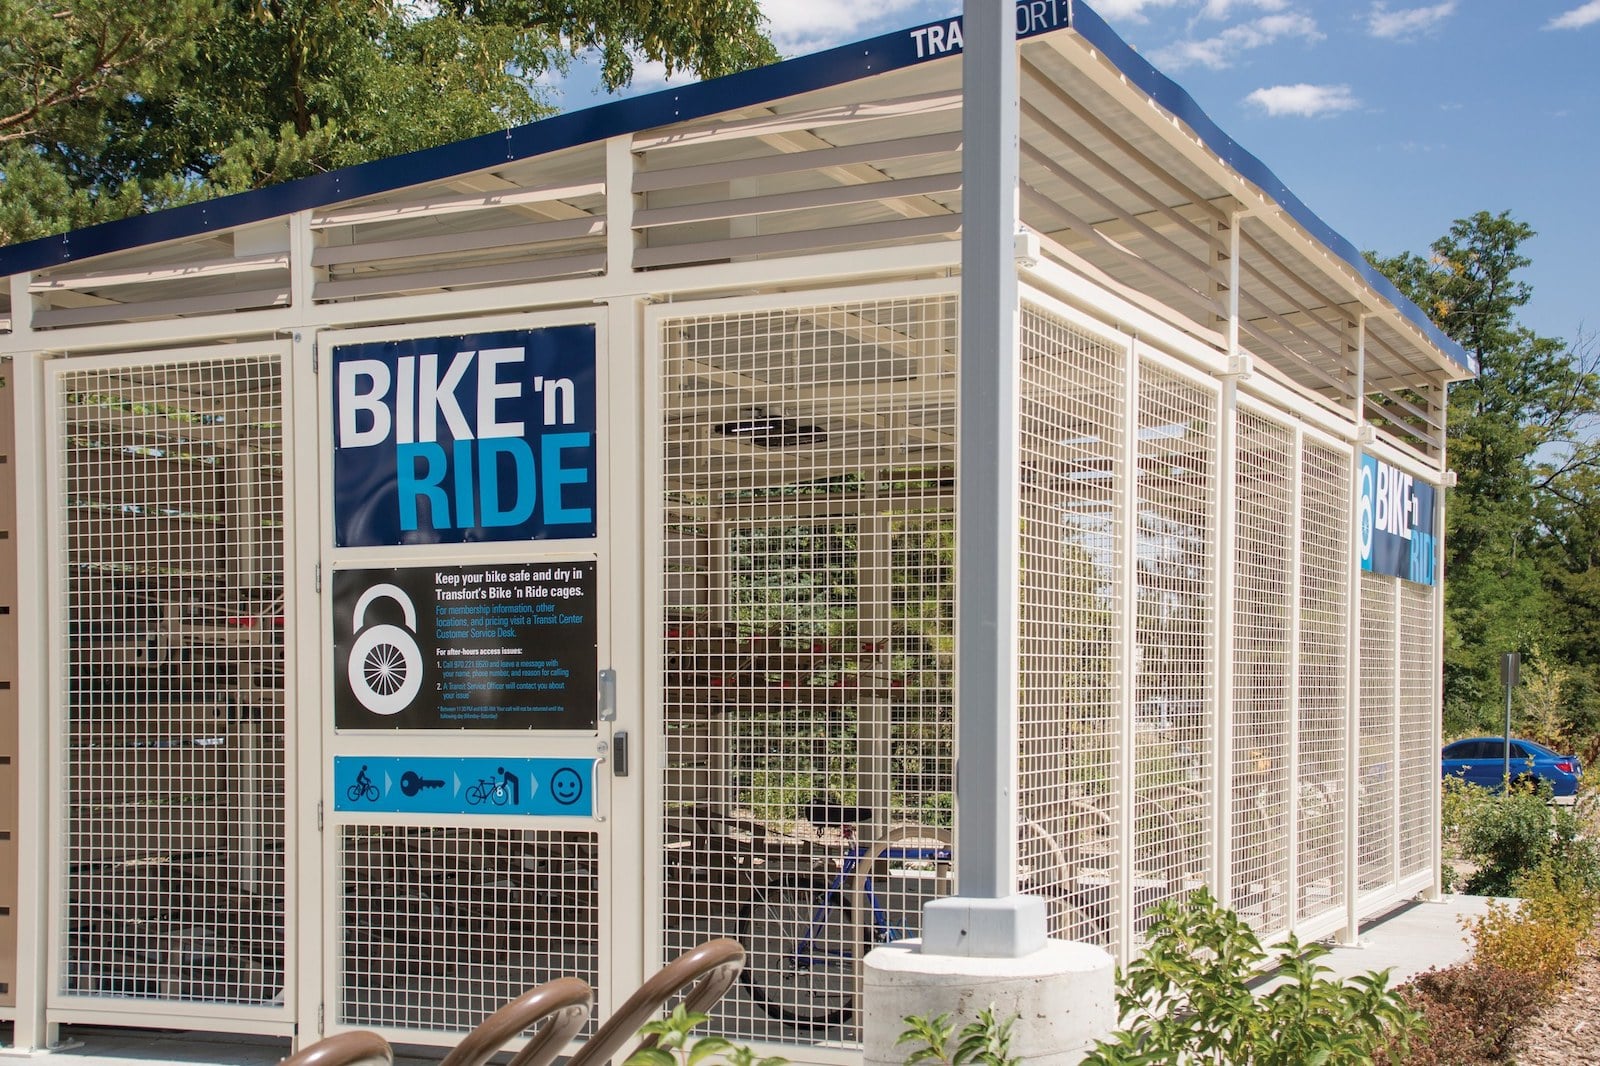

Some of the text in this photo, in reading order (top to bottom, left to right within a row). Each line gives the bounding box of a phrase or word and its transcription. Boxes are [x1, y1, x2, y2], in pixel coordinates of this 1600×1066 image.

[338, 346, 576, 449] BIKE 'n
[397, 432, 592, 531] RIDE
[1375, 461, 1413, 540] BIKE
[435, 568, 582, 586] Keep your bike safe and dry in
[489, 587, 511, 599] Bike
[525, 586, 547, 597] Ride
[551, 586, 584, 600] cages.
[436, 606, 447, 615] For
[449, 605, 490, 615] membership
[536, 603, 555, 612] other
[471, 616, 483, 626] and
[485, 616, 508, 627] pricing
[510, 615, 525, 624] visit
[533, 614, 557, 624] Transit
[559, 614, 583, 623] Center
[436, 629, 469, 639] Customer
[471, 628, 496, 638] Service
[436, 648, 446, 656] For
